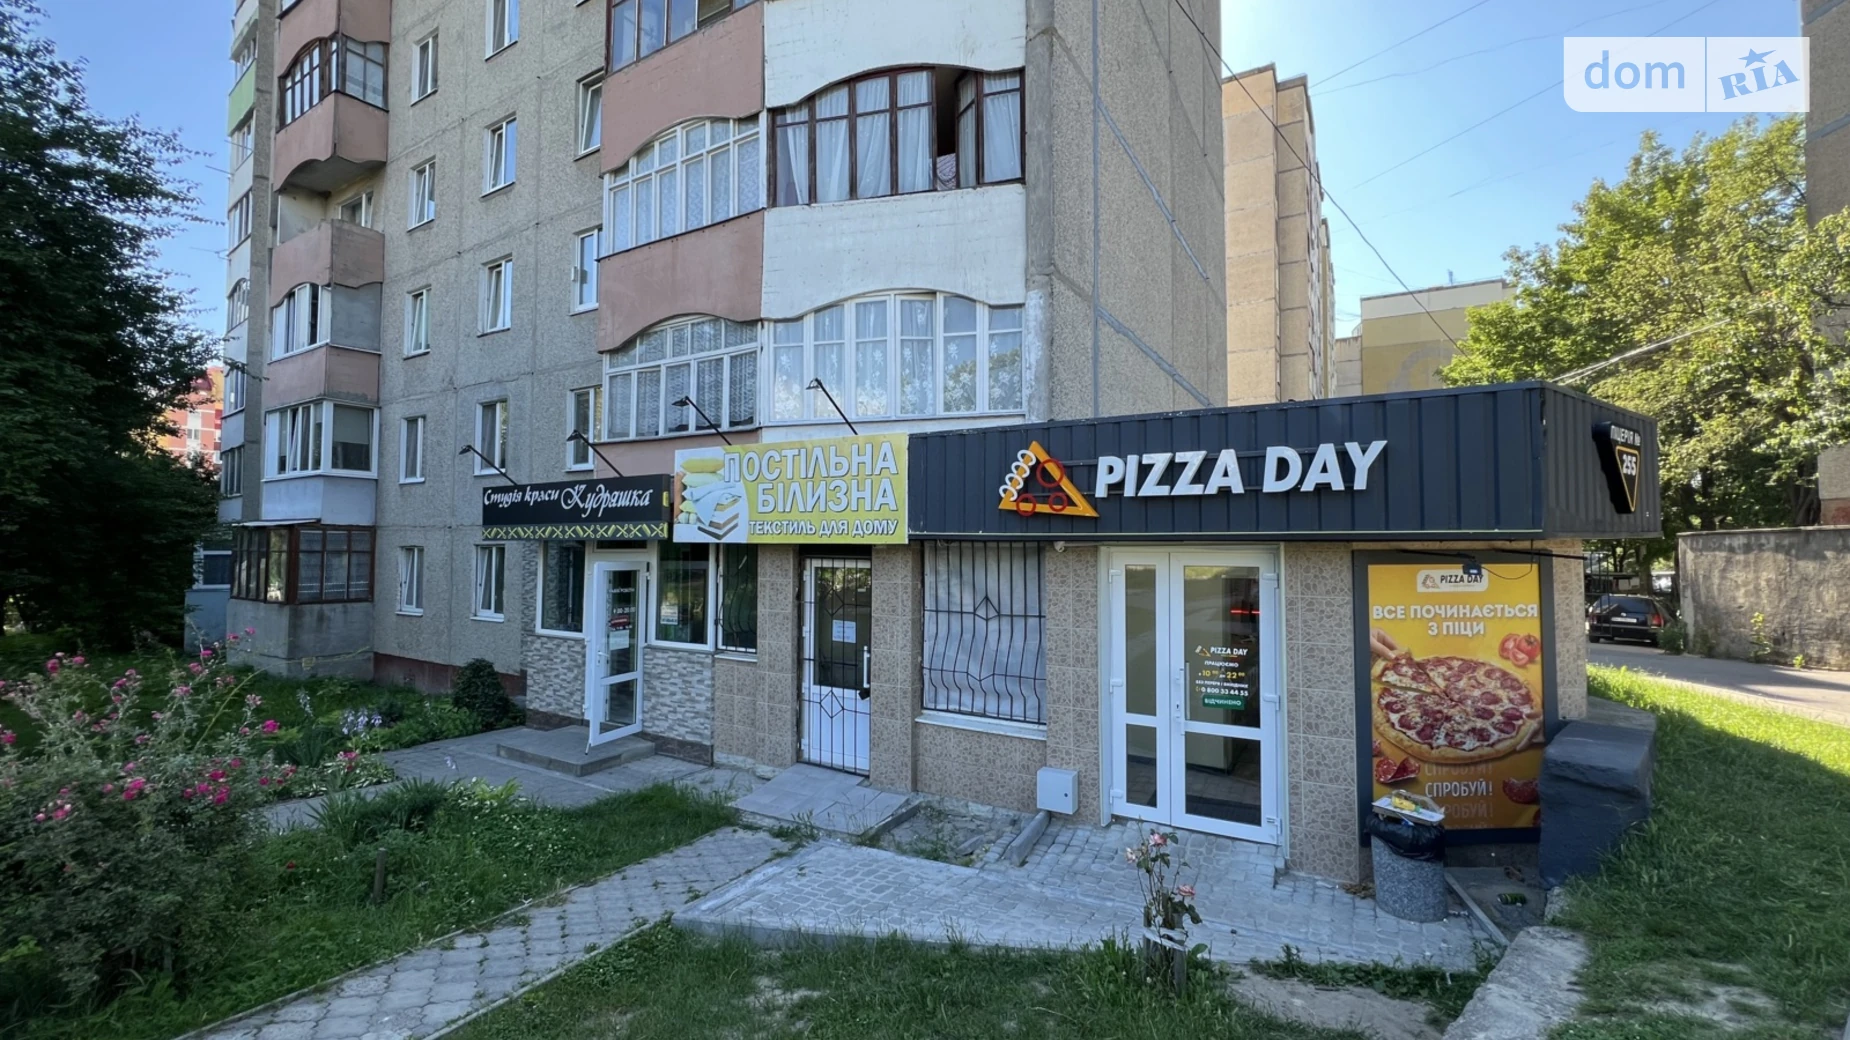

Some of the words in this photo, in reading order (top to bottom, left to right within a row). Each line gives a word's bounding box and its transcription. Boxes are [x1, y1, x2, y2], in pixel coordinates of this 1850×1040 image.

[723, 441, 898, 482] ПОСТІЛЬНА
[1095, 449, 1245, 498] PIZZA
[1262, 440, 1388, 493] DAY
[484, 489, 522, 508] Студія
[524, 486, 560, 506] краси
[560, 484, 653, 518] Кудряшка
[757, 478, 898, 514] БІЛИЗНА
[749, 519, 816, 535] ТЕКСТИЛЬ
[818, 519, 849, 538] ДЛЯ
[852, 519, 898, 538] ДОМУ
[1440, 574, 1465, 583] PIZZA
[1467, 574, 1484, 583] DAY
[1372, 605, 1406, 619] ВСЕ
[1410, 604, 1538, 619] ПОЧИНАЄТЬСЯ
[1428, 622, 1438, 636] З
[1442, 622, 1485, 637] ПІЦИ
[1233, 648, 1248, 656] DAY
